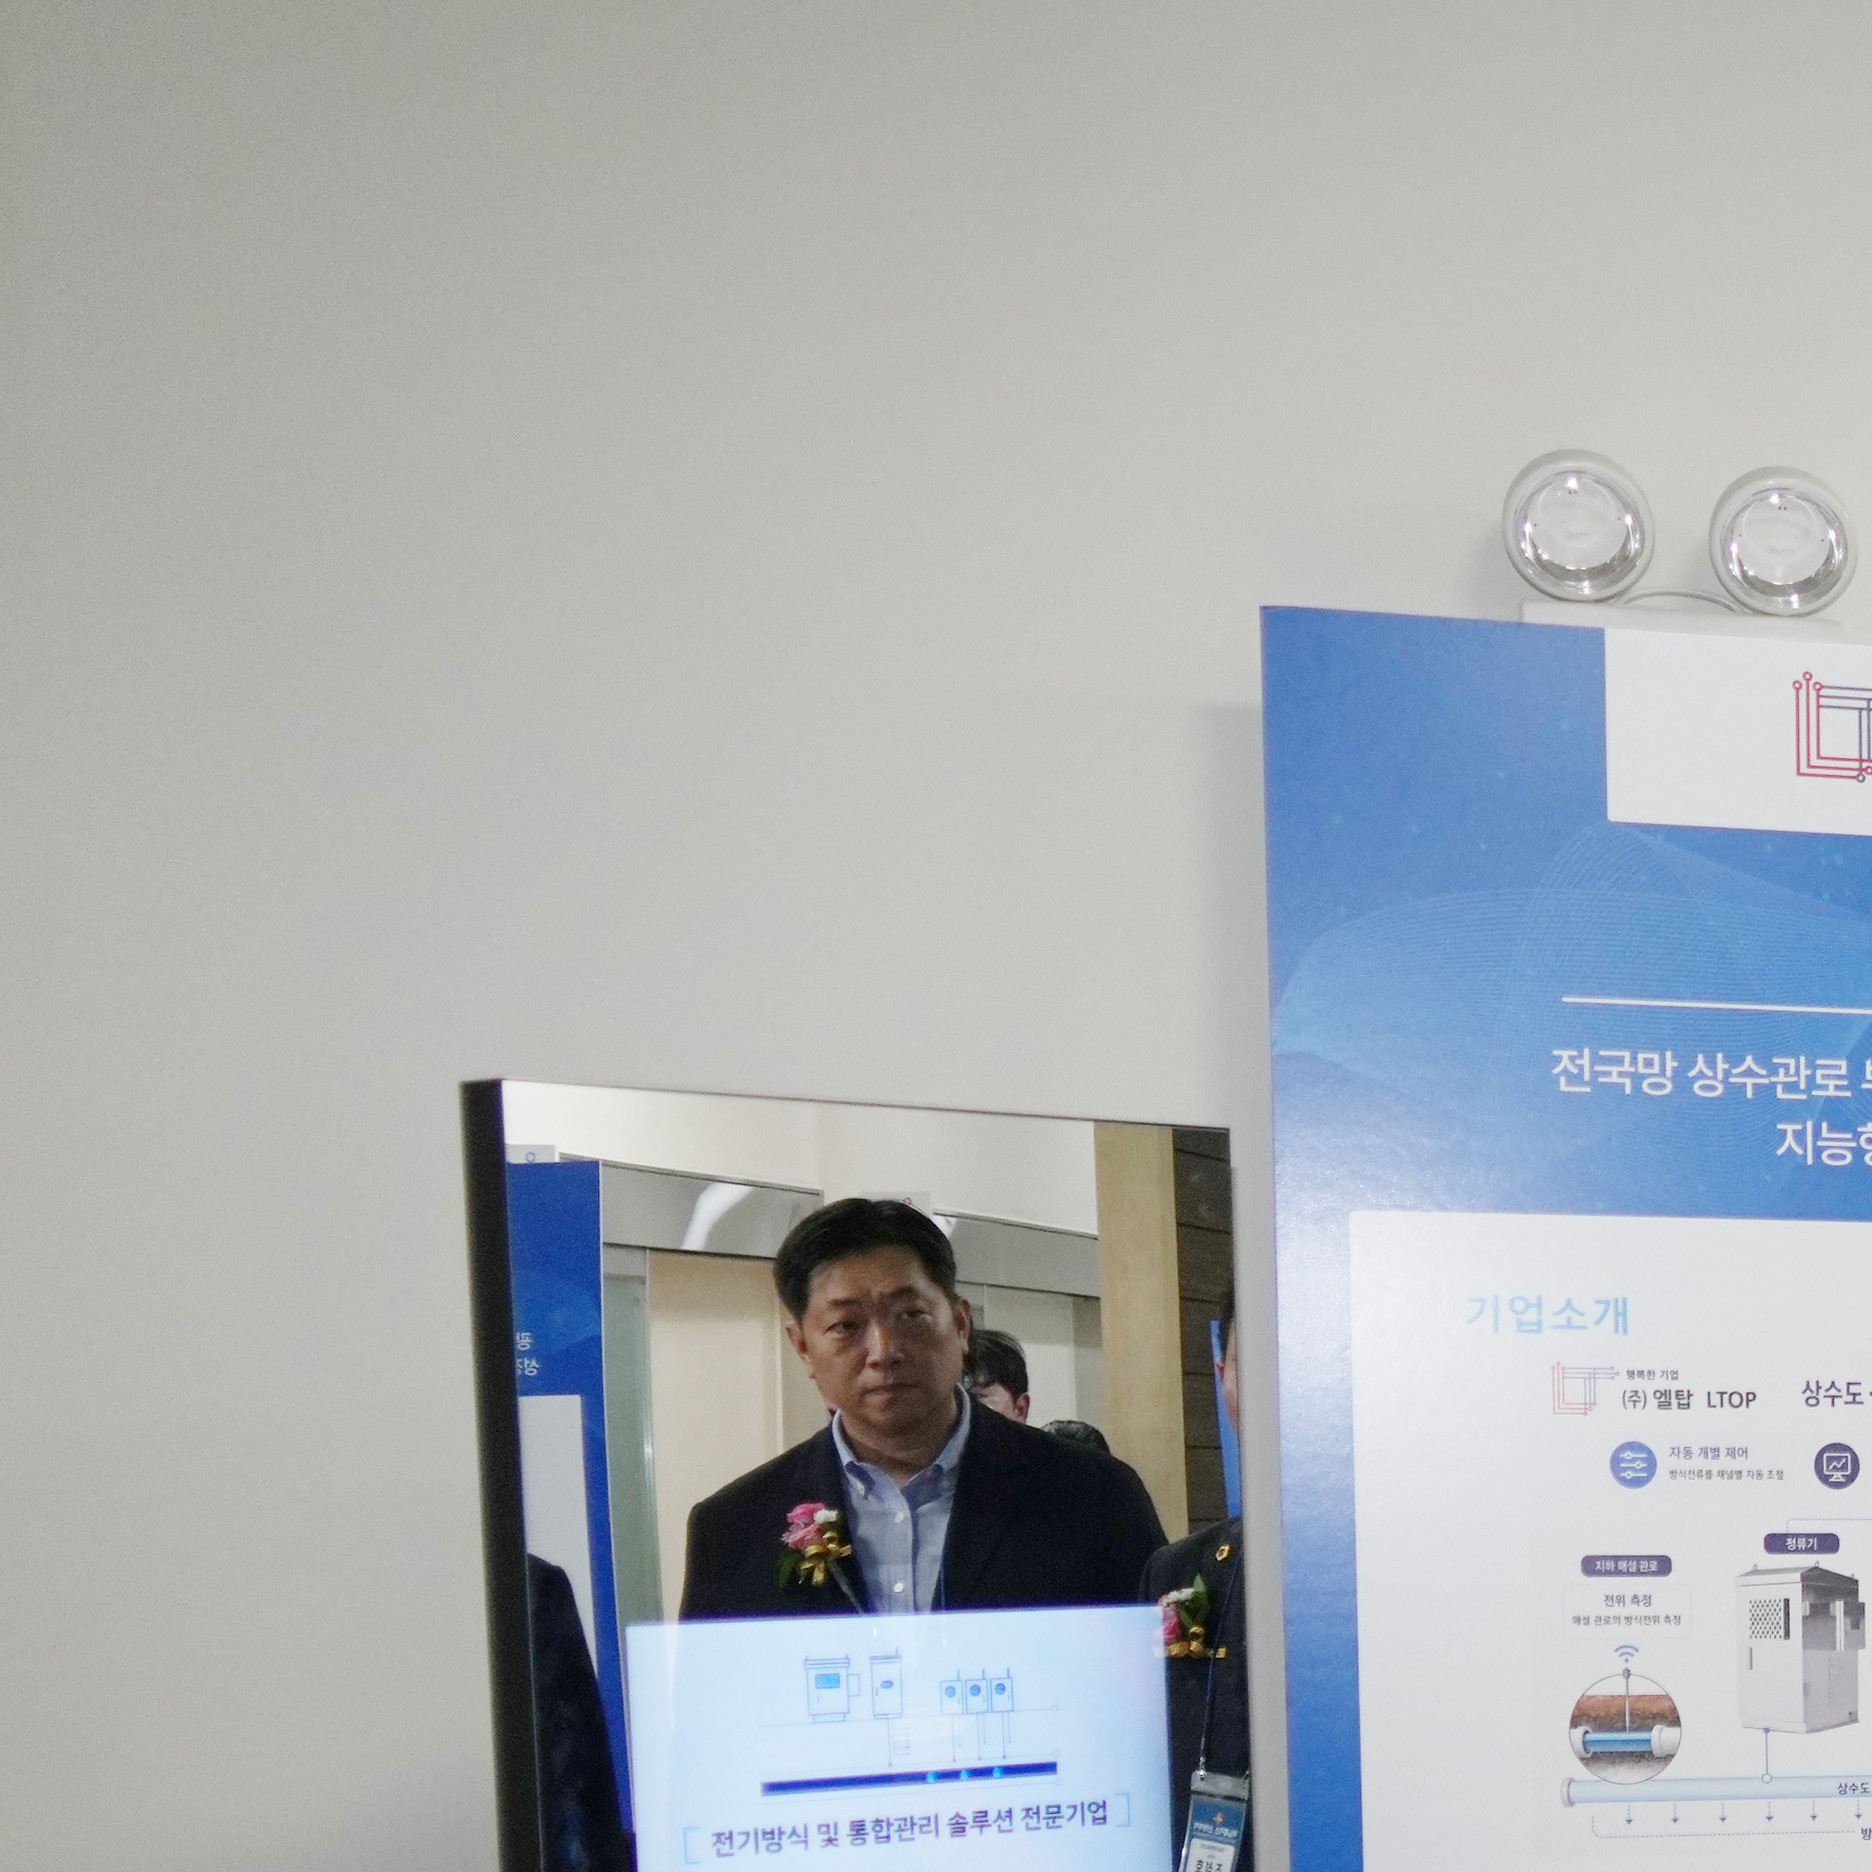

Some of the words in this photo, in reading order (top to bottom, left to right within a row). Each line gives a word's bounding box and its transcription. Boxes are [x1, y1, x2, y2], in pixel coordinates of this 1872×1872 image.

[1551, 1047, 1679, 1096] 전국망
[1686, 1052, 1852, 1100] 상수관로
[1468, 1294, 1629, 1337] 기업소개
[1626, 1369, 1656, 1381] 행복한
[1660, 1370, 1679, 1381] 기업
[1622, 1390, 1647, 1410] (주)
[1653, 1389, 1694, 1411] 엘탑
[1707, 1391, 1756, 1409] LTOP
[1669, 1447, 1693, 1460] 자동
[1697, 1447, 1721, 1460] 개별
[1725, 1447, 1748, 1460] 제어
[1785, 1538, 1817, 1551] 정류기
[1603, 1594, 1626, 1608] 전위
[1630, 1594, 1652, 1608] 측정
[1837, 1782, 1870, 1795] 상수도
[711, 1823, 809, 1858] 전기방식
[817, 1821, 839, 1848] 및
[846, 1813, 939, 1846] 통합관리
[947, 1806, 1014, 1838] 솔루션
[1021, 1799, 1108, 1831] 전문기업
